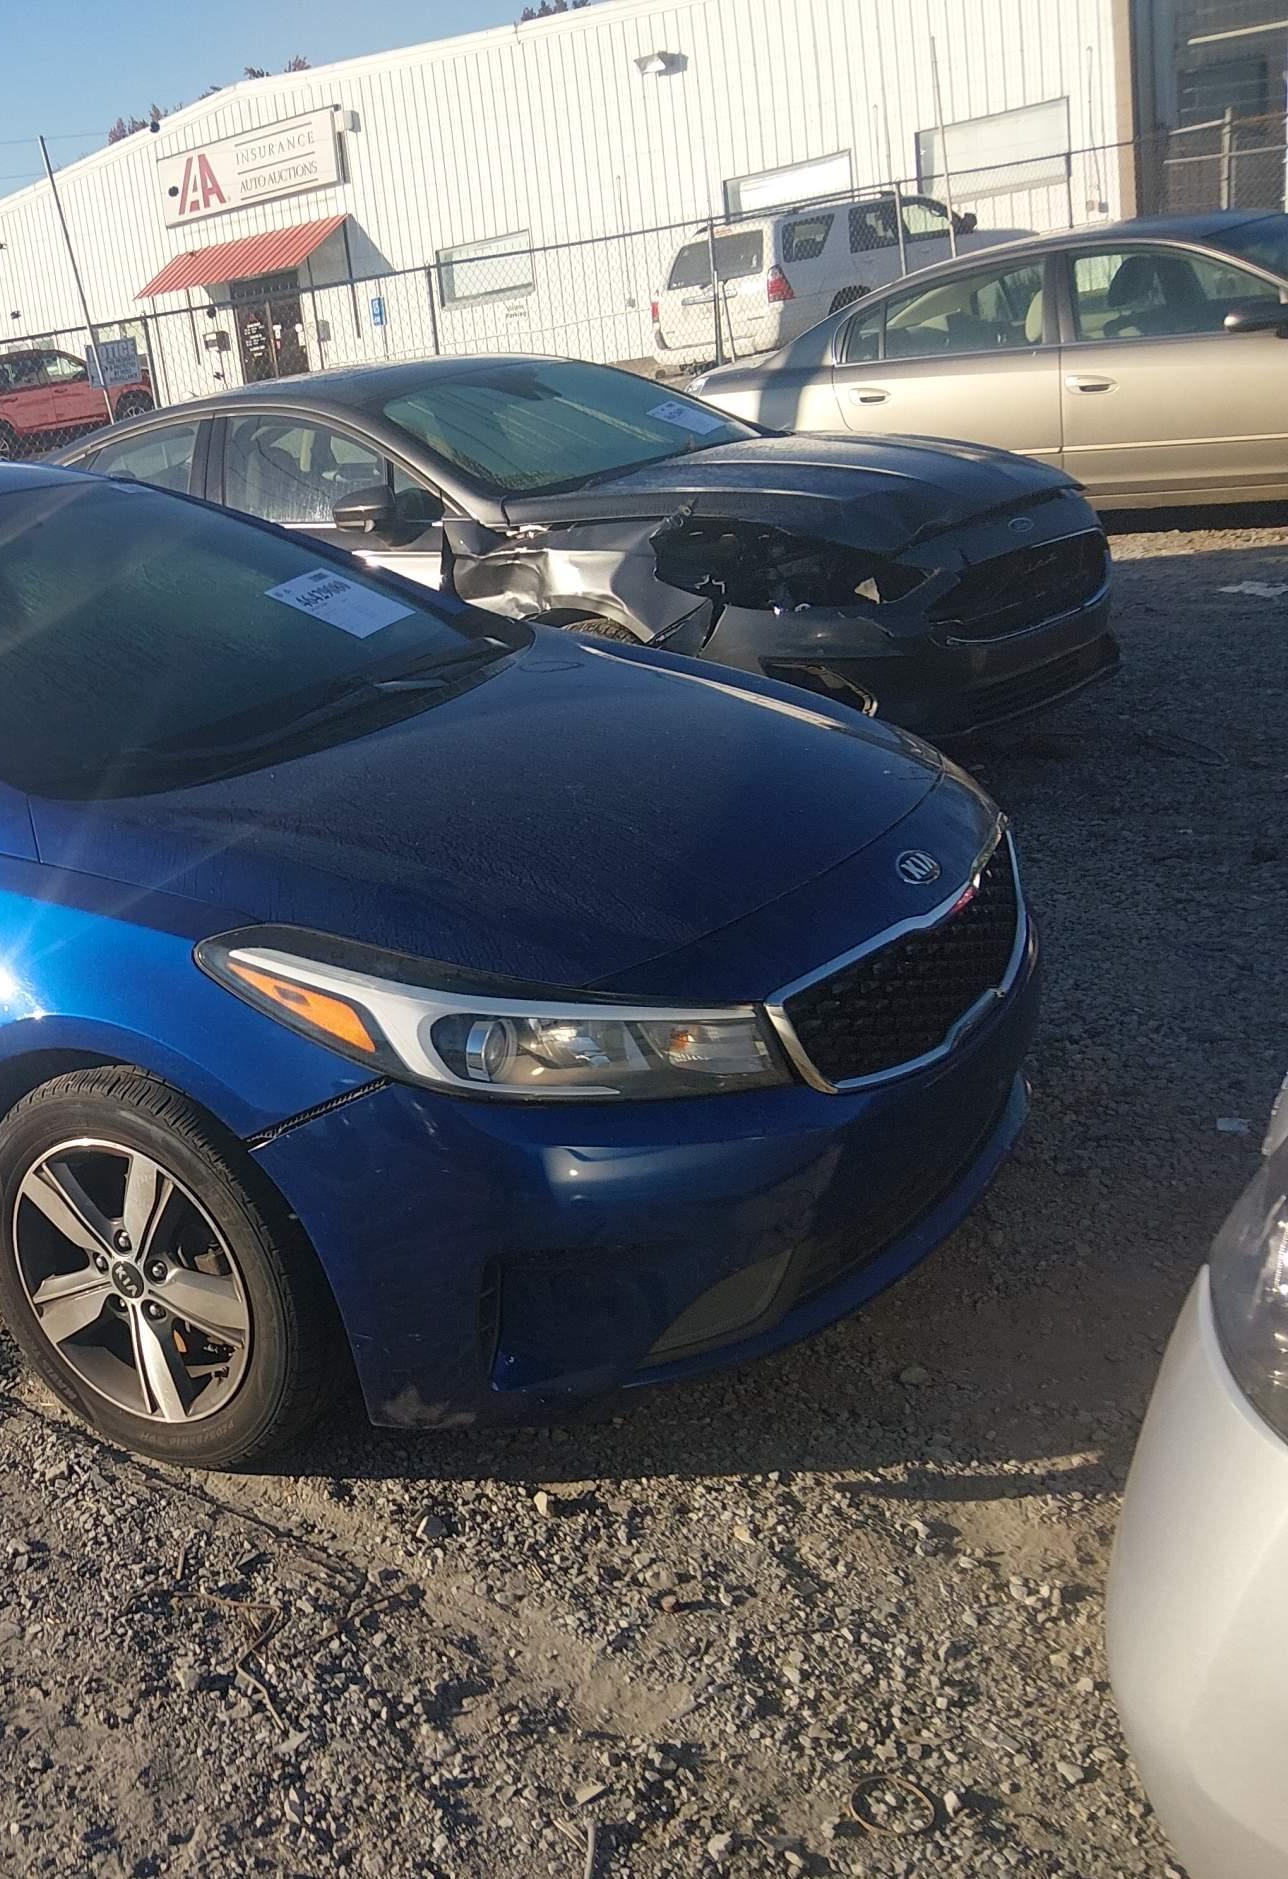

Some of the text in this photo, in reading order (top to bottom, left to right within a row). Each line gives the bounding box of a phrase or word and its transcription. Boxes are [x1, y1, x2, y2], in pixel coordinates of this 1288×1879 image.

[236, 130, 315, 165] INSURANCE
[240, 160, 318, 194] AUTO AUCTIONS
[900, 852, 938, 880] KIA
[115, 1265, 138, 1297] KIA
